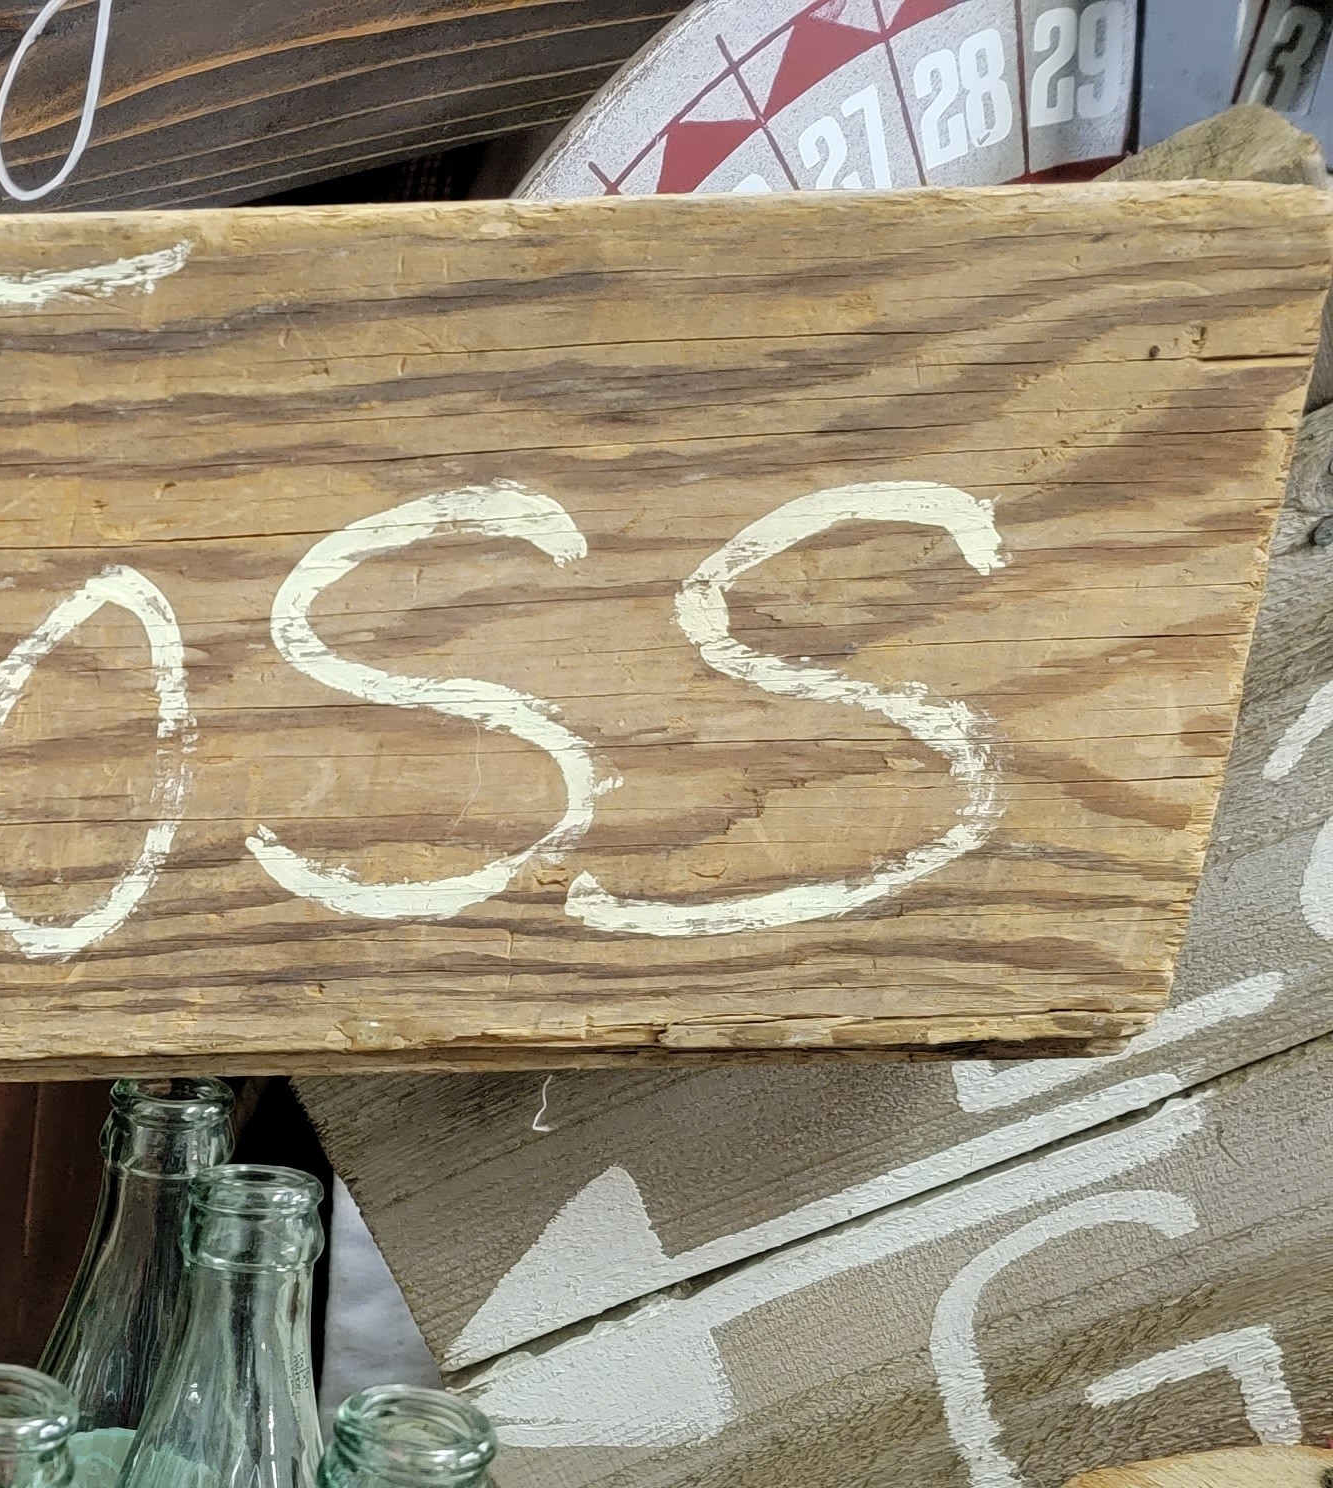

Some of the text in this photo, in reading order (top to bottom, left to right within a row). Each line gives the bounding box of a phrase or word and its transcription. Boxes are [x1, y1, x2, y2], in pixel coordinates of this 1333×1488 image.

[798, 85, 893, 190] 27
[912, 28, 1014, 170] 28
[1031, 1, 1128, 128] 29
